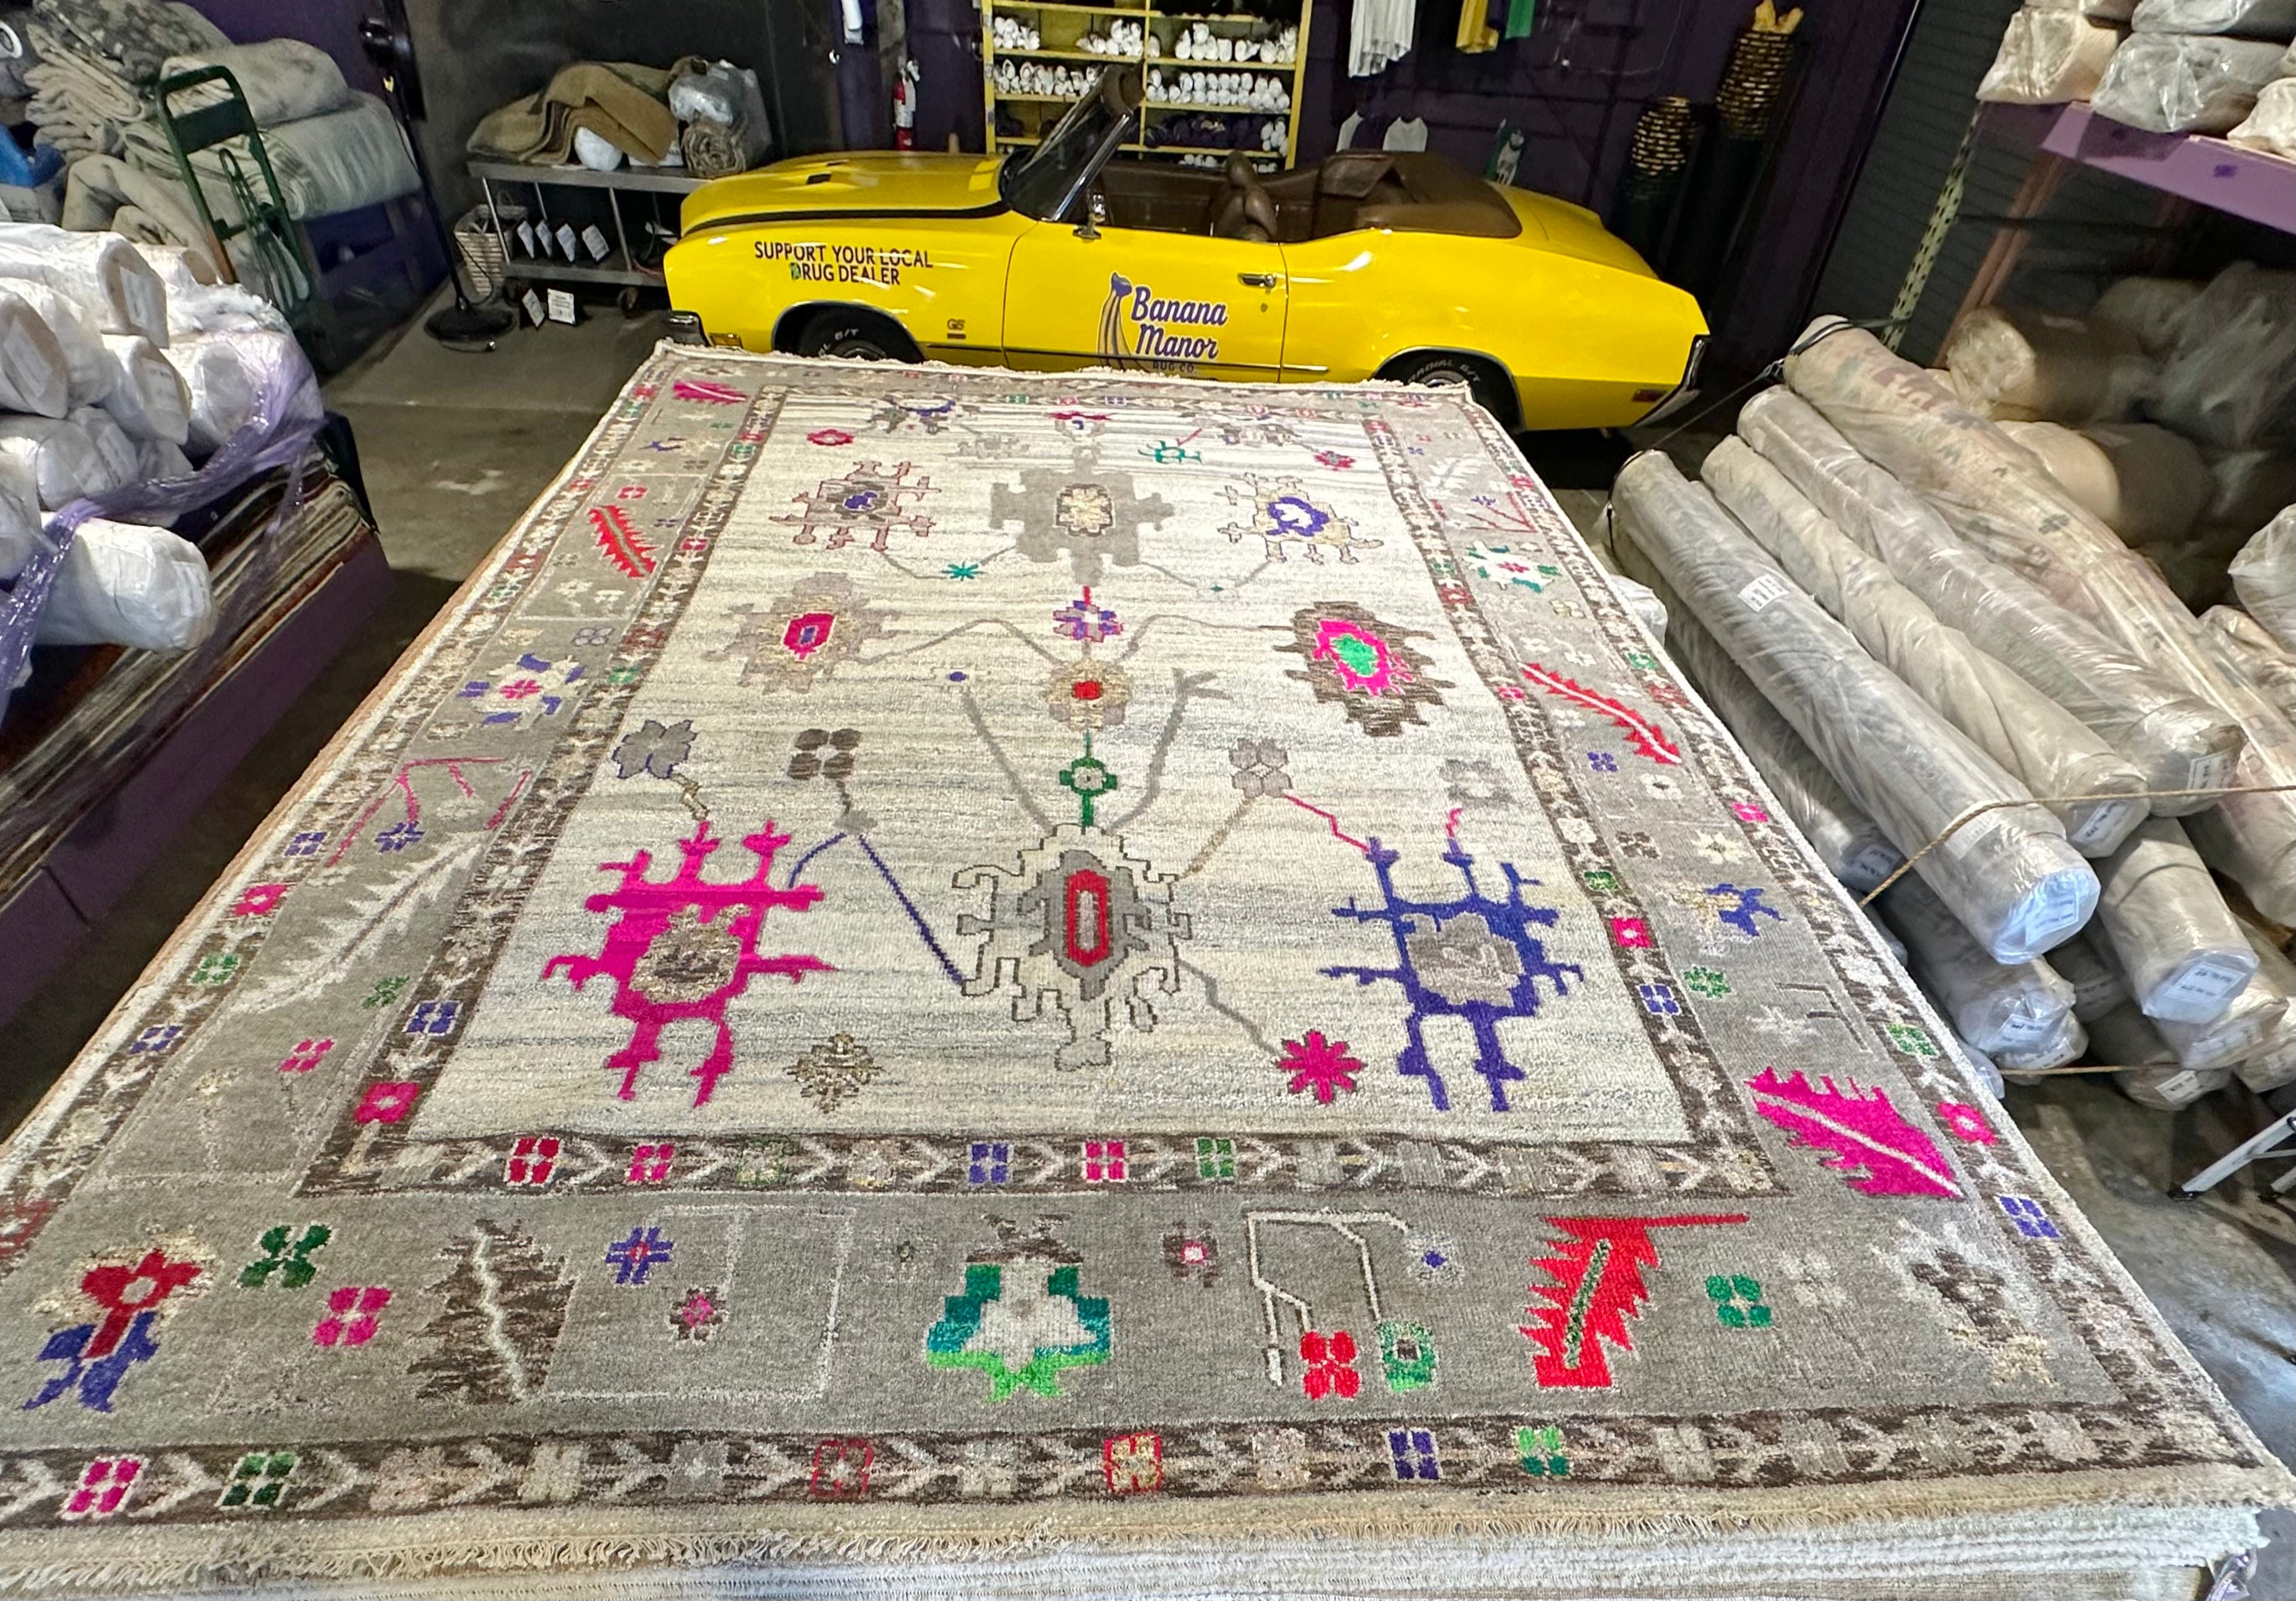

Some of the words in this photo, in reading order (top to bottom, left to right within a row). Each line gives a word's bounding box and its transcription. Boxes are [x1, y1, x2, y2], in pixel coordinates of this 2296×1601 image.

[754, 241, 827, 262] SUPPORT
[832, 245, 876, 265] YOUR
[880, 248, 934, 268] LOCAL
[790, 262, 835, 281] DRUG
[839, 265, 900, 285] DEALER
[1131, 286, 1228, 325] Banana
[1135, 323, 1219, 359] Manor
